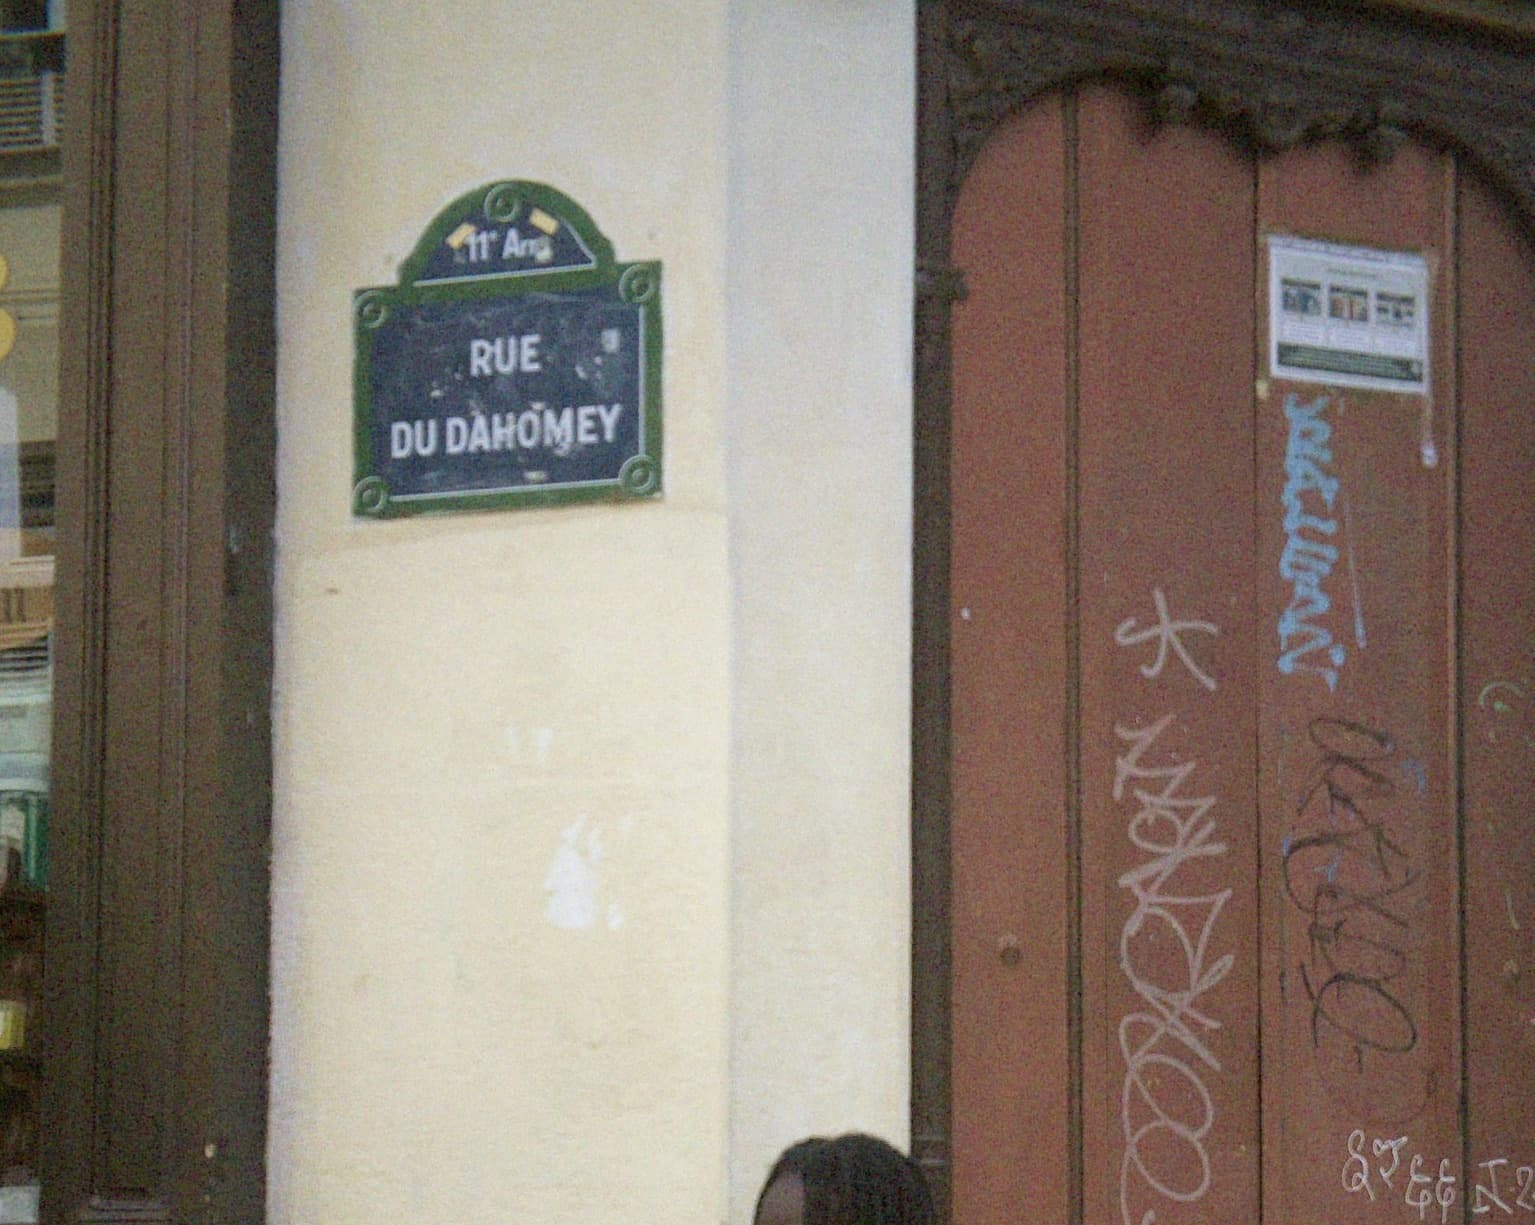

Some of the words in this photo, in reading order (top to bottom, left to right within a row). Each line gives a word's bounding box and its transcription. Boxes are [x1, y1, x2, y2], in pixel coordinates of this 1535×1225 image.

[470, 334, 542, 377] RUE
[391, 418, 438, 459] DU
[446, 403, 621, 455] DAHOMEY
